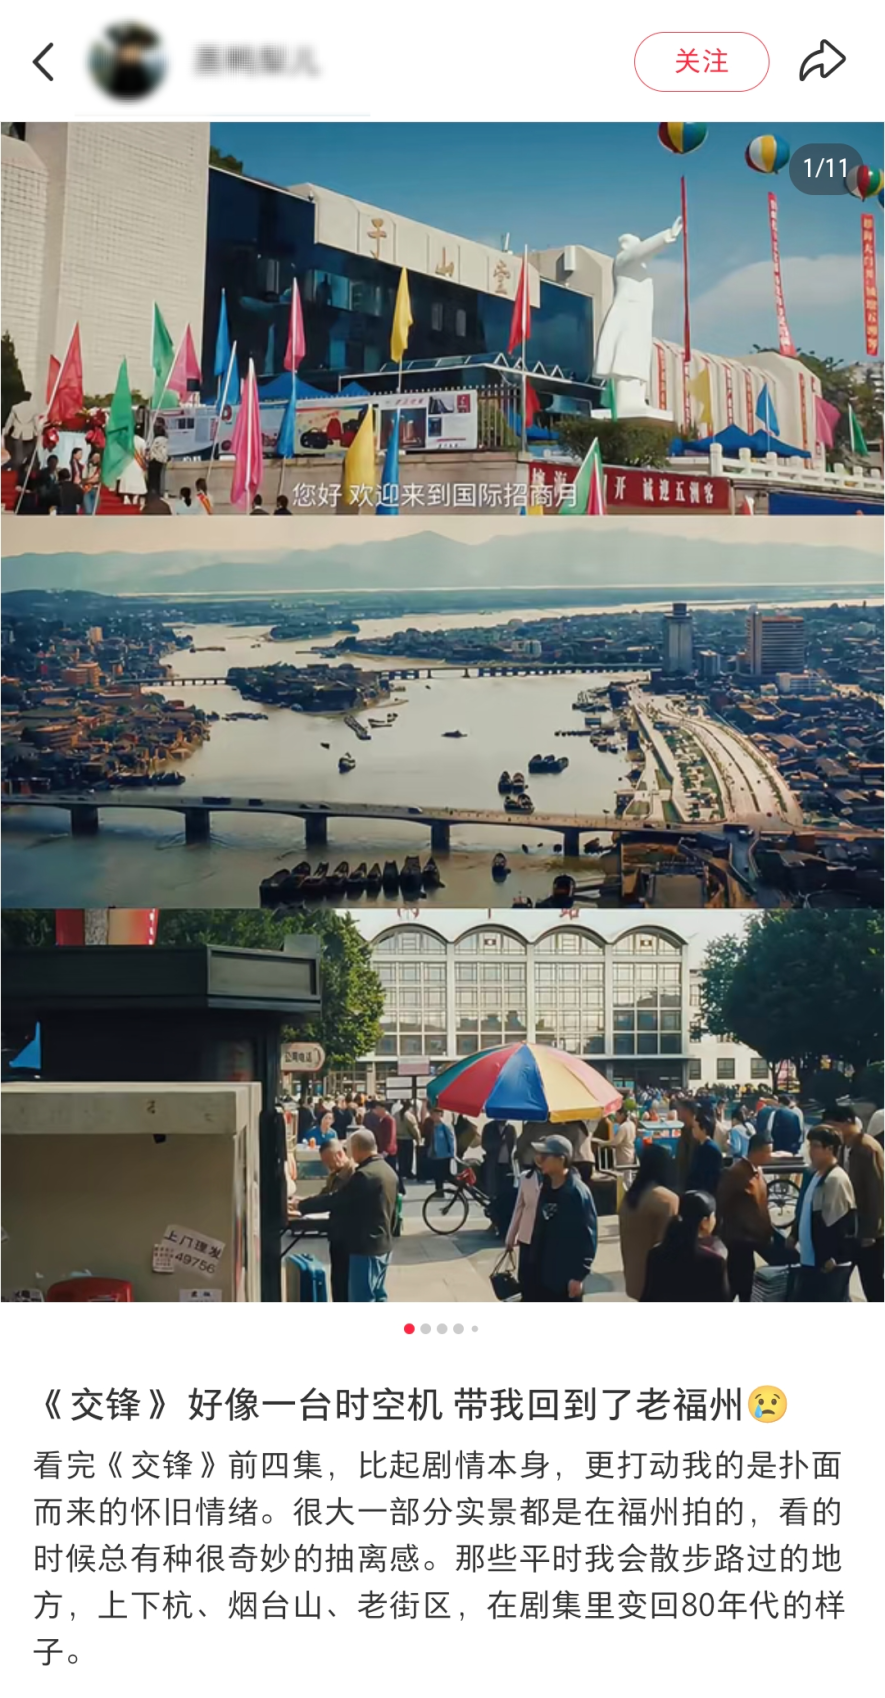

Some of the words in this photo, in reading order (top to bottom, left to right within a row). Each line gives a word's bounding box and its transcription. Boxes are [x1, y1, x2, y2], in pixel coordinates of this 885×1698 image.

[642, 477, 714, 504] 诚迎五洲客
[164, 1230, 222, 1260] 上门理发
[175, 1252, 216, 1274] 49756
